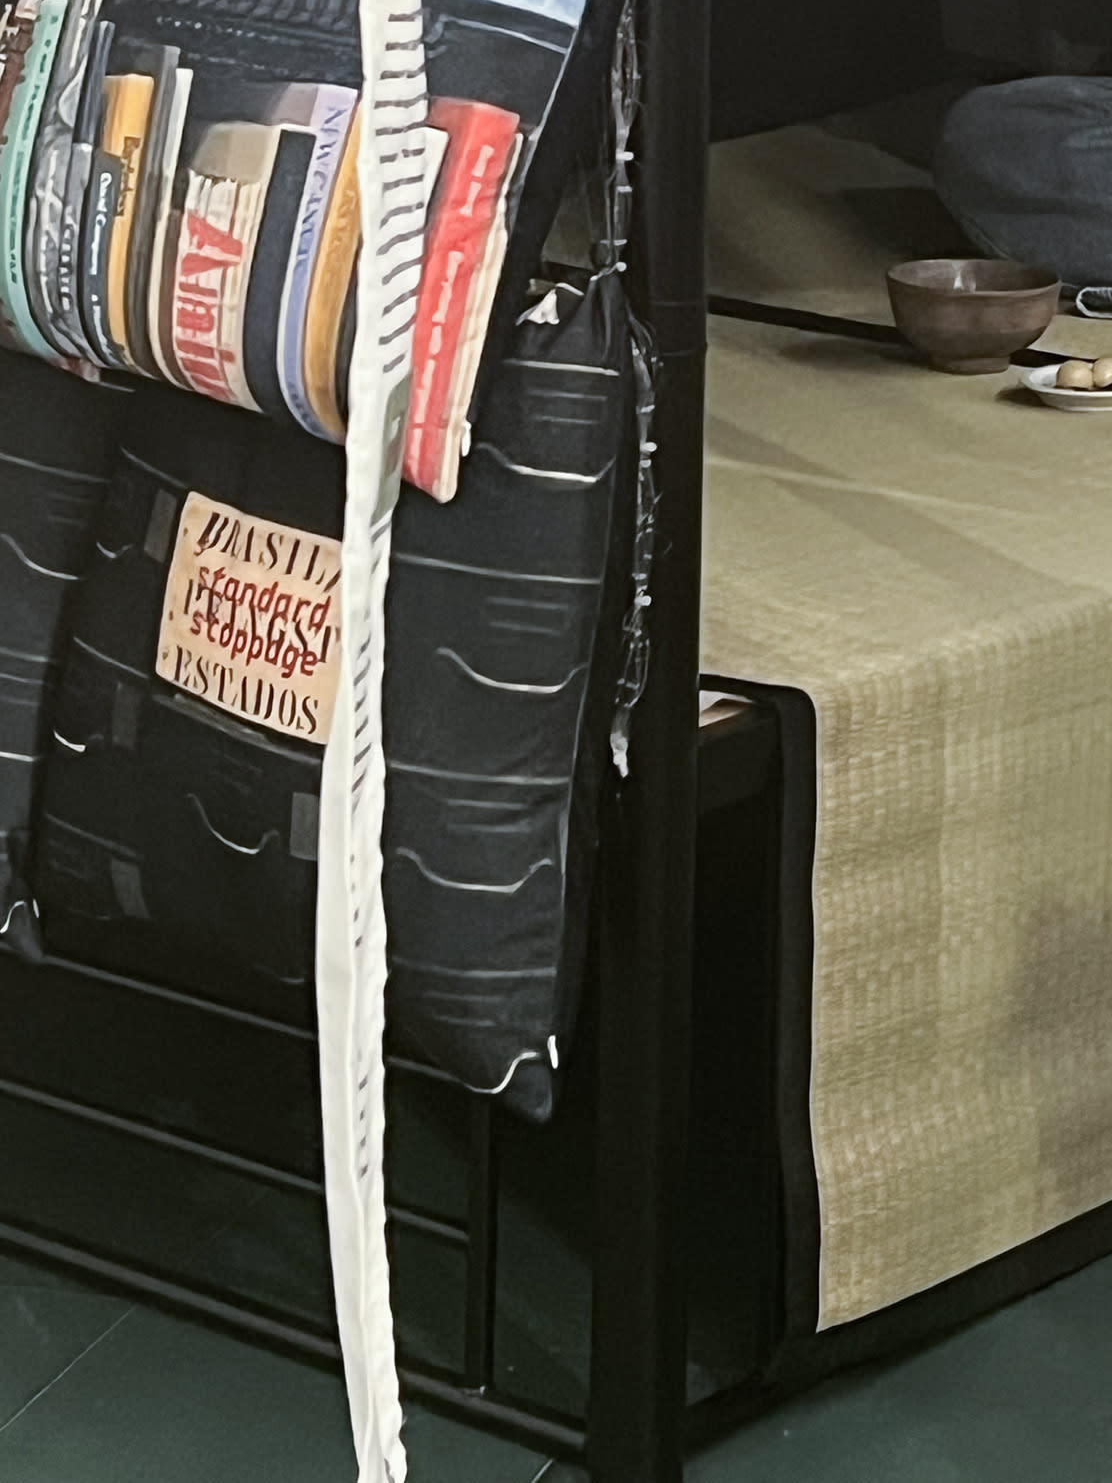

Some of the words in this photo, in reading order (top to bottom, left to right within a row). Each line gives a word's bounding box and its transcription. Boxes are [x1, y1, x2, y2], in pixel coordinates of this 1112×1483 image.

[199, 565, 332, 636] standard
[190, 610, 320, 679] stoppage
[173, 645, 319, 734] ESTADOS
